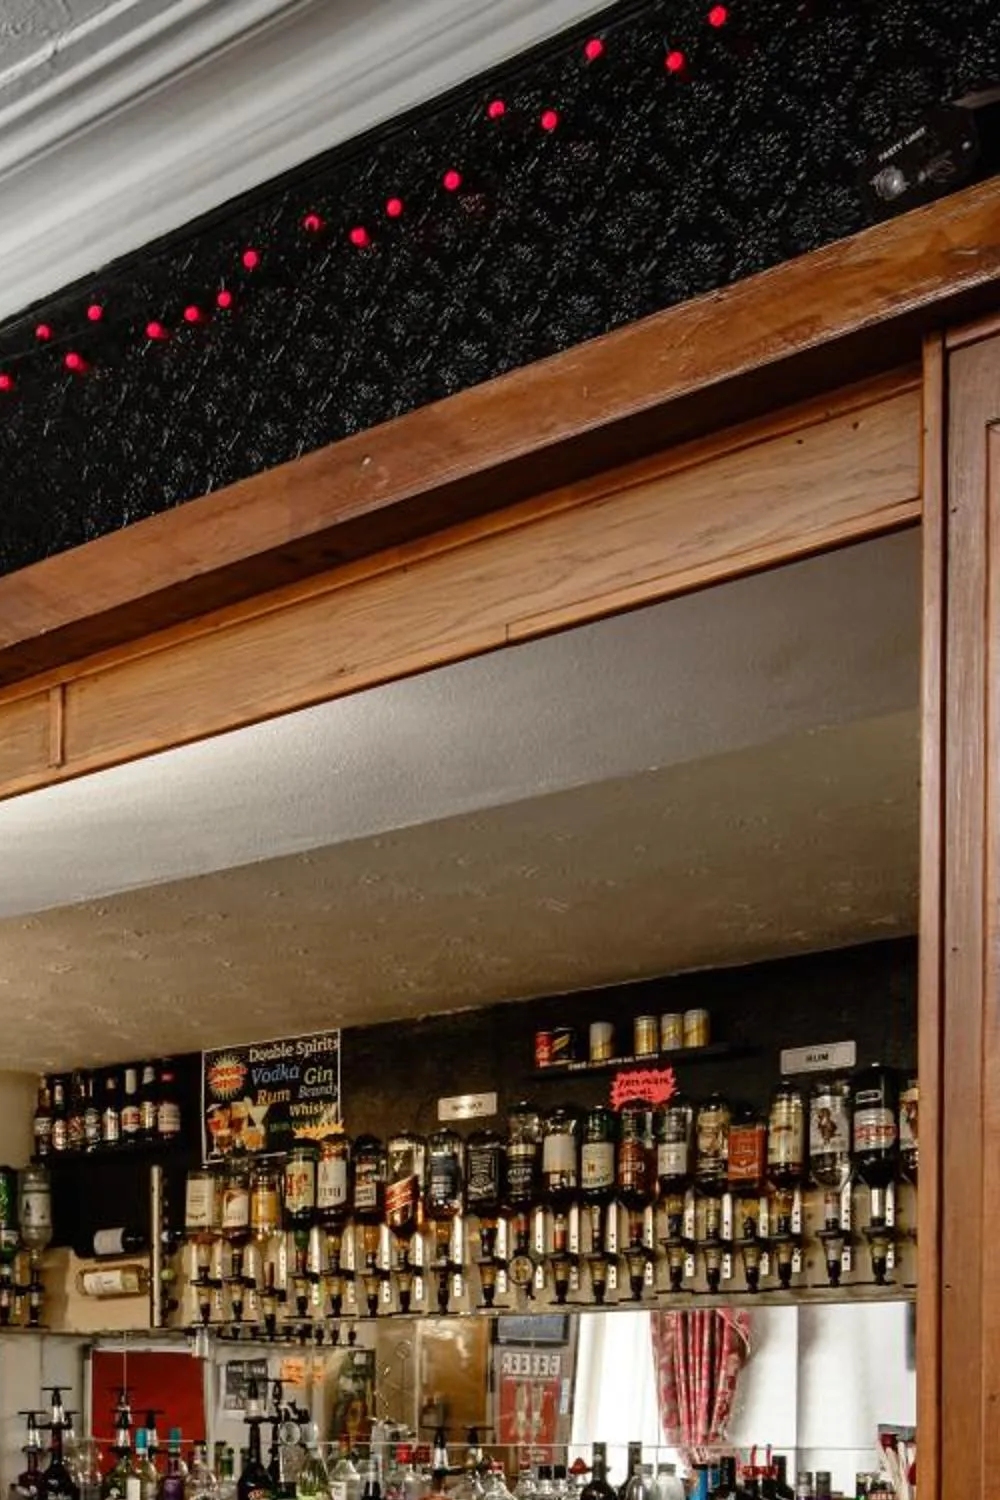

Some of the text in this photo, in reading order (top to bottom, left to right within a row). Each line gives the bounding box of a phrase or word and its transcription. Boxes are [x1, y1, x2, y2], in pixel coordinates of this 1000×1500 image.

[249, 1037, 338, 1062] Double Spirits
[251, 1063, 333, 1085] Vodka Gin
[257, 1082, 338, 1105] Rum Brandy
[289, 1101, 337, 1117] Whisky
